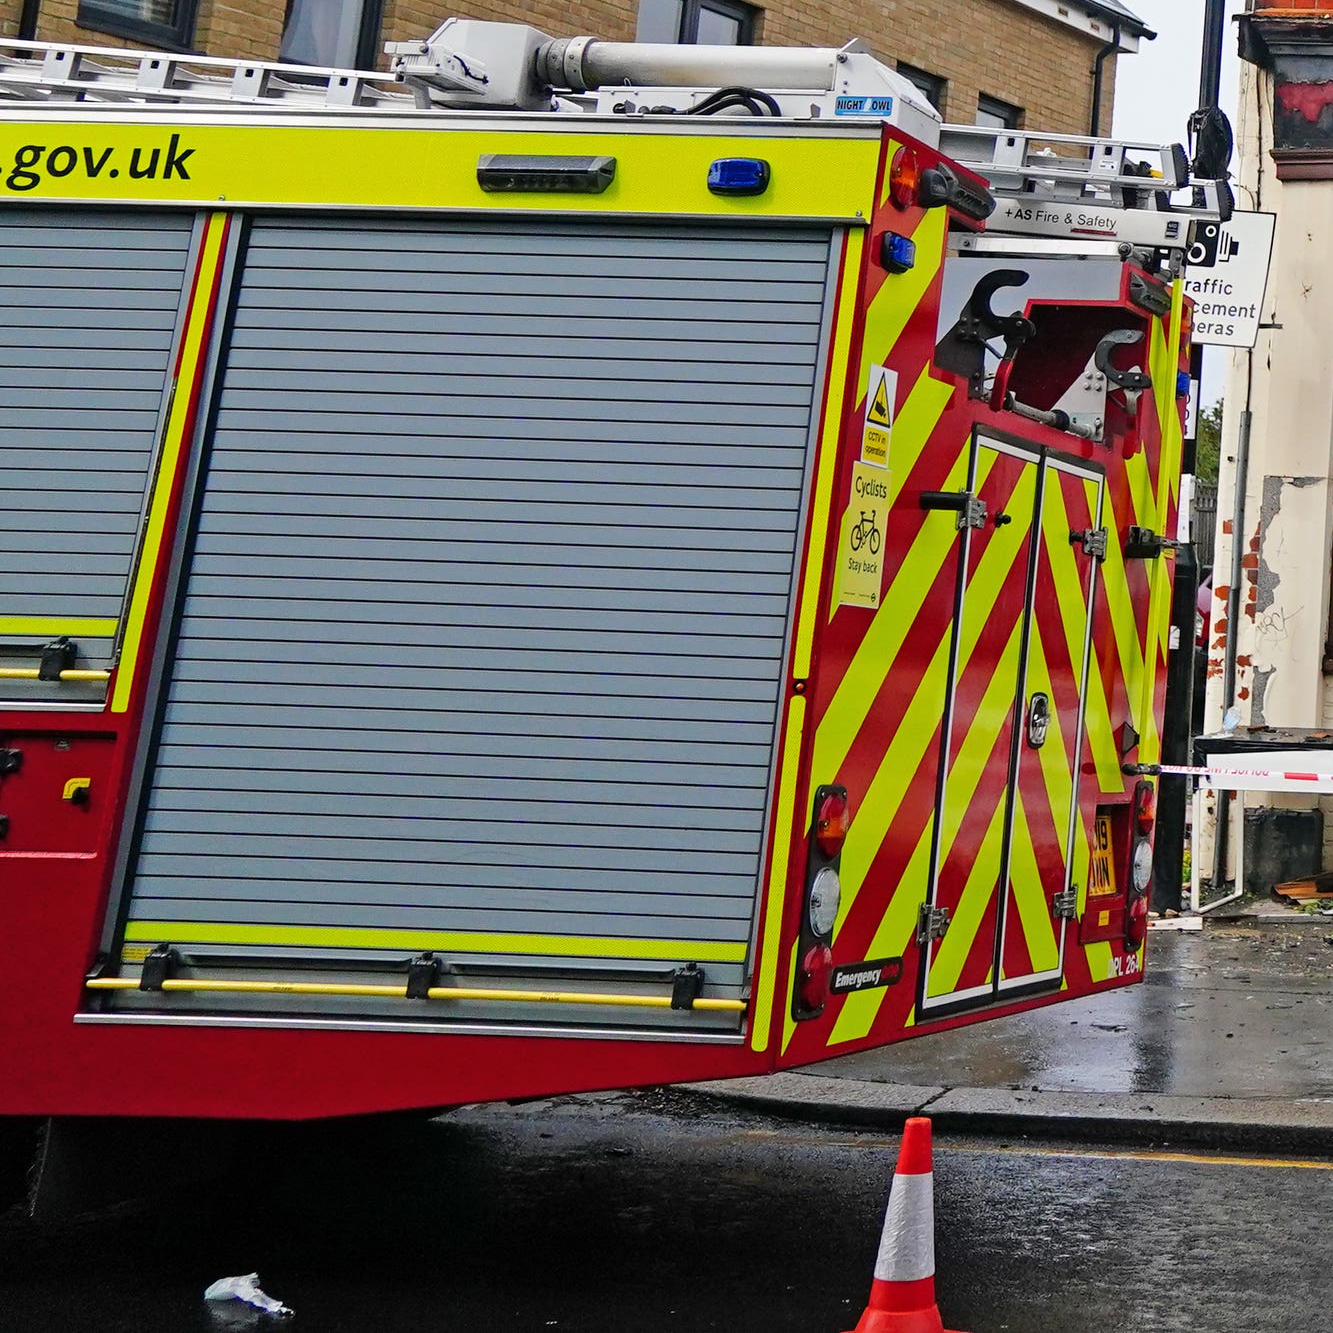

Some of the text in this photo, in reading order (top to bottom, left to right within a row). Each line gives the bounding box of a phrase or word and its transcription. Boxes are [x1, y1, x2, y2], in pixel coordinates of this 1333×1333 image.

[837, 100, 890, 111] NIGHT OWL
[0, 133, 196, 192] gov.uk
[1035, 210, 1059, 224] Fire
[1064, 213, 1073, 224] &
[1077, 214, 1117, 231] Safety
[1184, 278, 1233, 295] raffic
[868, 430, 881, 443] CCTV
[865, 444, 887, 458] operation
[855, 475, 888, 499] Cyclists
[848, 557, 878, 575] Stay back
[835, 969, 882, 989] Emergency
